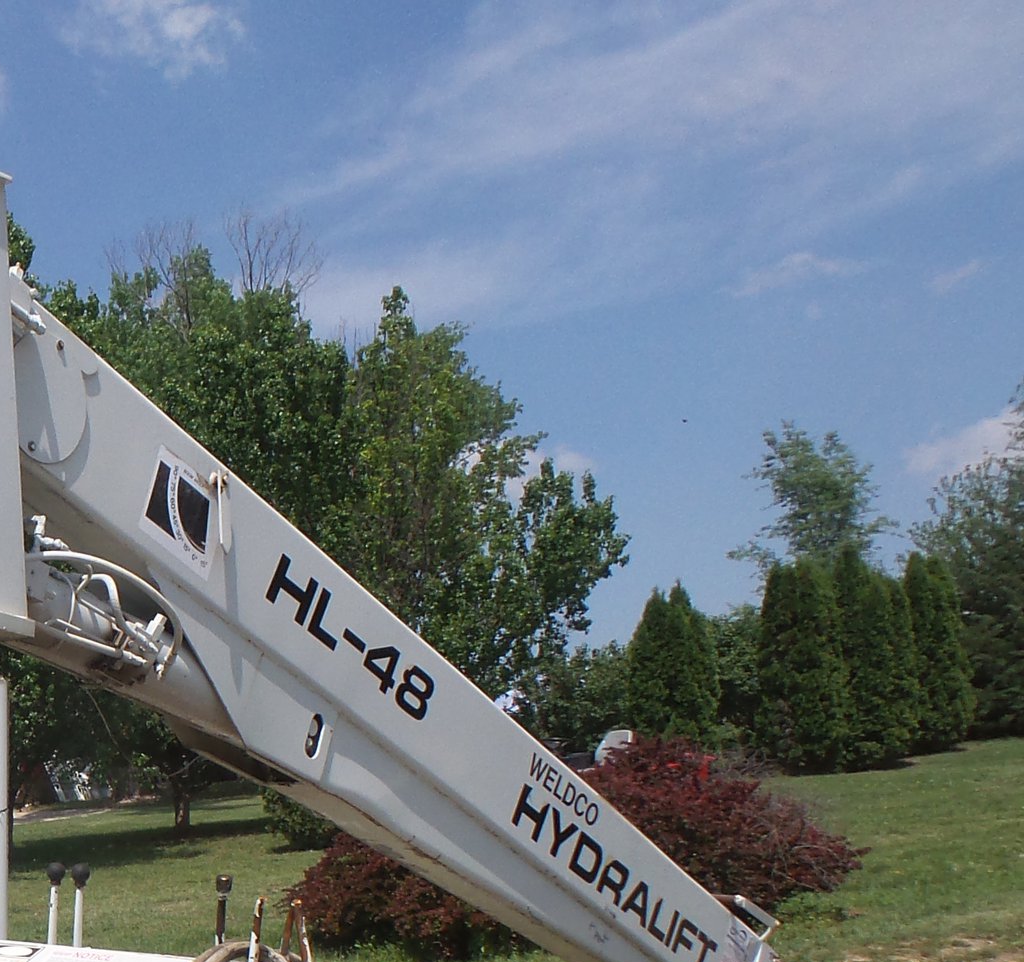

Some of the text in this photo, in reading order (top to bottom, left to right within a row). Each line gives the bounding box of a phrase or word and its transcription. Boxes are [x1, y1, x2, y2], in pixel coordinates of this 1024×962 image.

[265, 553, 435, 721] HL-48
[529, 752, 599, 826] WELDCO
[72, 951, 114, 961] NOTICE
